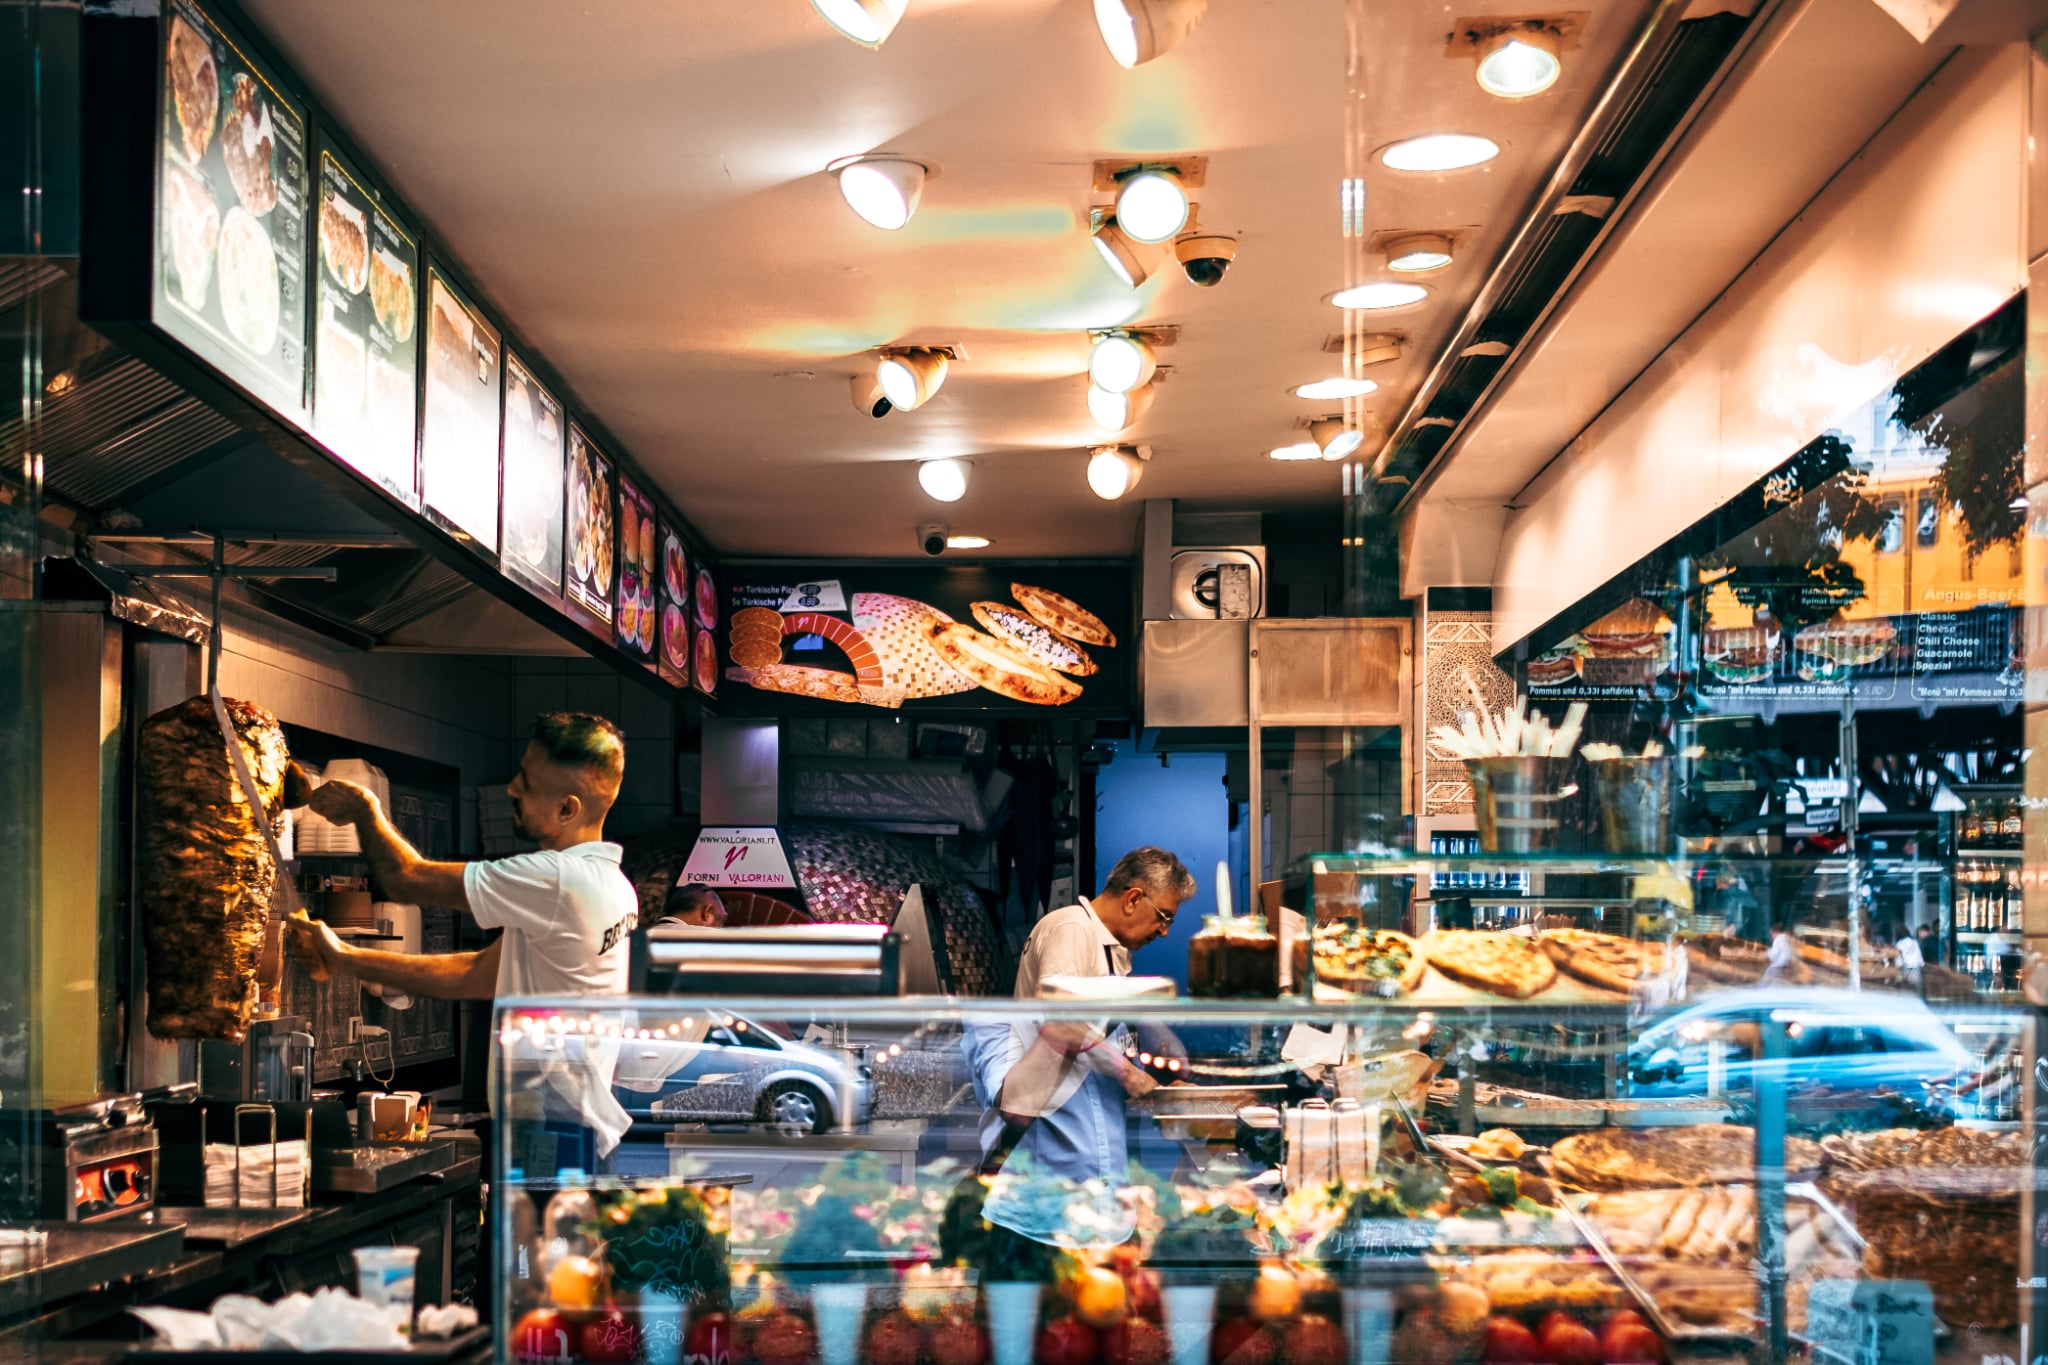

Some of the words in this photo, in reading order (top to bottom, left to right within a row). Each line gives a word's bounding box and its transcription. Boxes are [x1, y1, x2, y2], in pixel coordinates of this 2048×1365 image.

[1920, 612, 1957, 621] Classic
[1918, 636, 1941, 646] Chili
[1942, 636, 1980, 646] Cheese
[1916, 649, 1973, 658] Guacamole
[1915, 661, 1952, 671] Spezial
[1529, 686, 1561, 695] Pommes
[1563, 686, 1577, 695] und
[1601, 686, 1634, 695] softdrink
[1745, 685, 1777, 695] Pommes
[1778, 685, 1793, 695] und
[1960, 687, 1992, 697] Pommes
[1993, 687, 2007, 697] und
[687, 872, 720, 882] FORNI
[728, 873, 785, 883] VALORIANI
